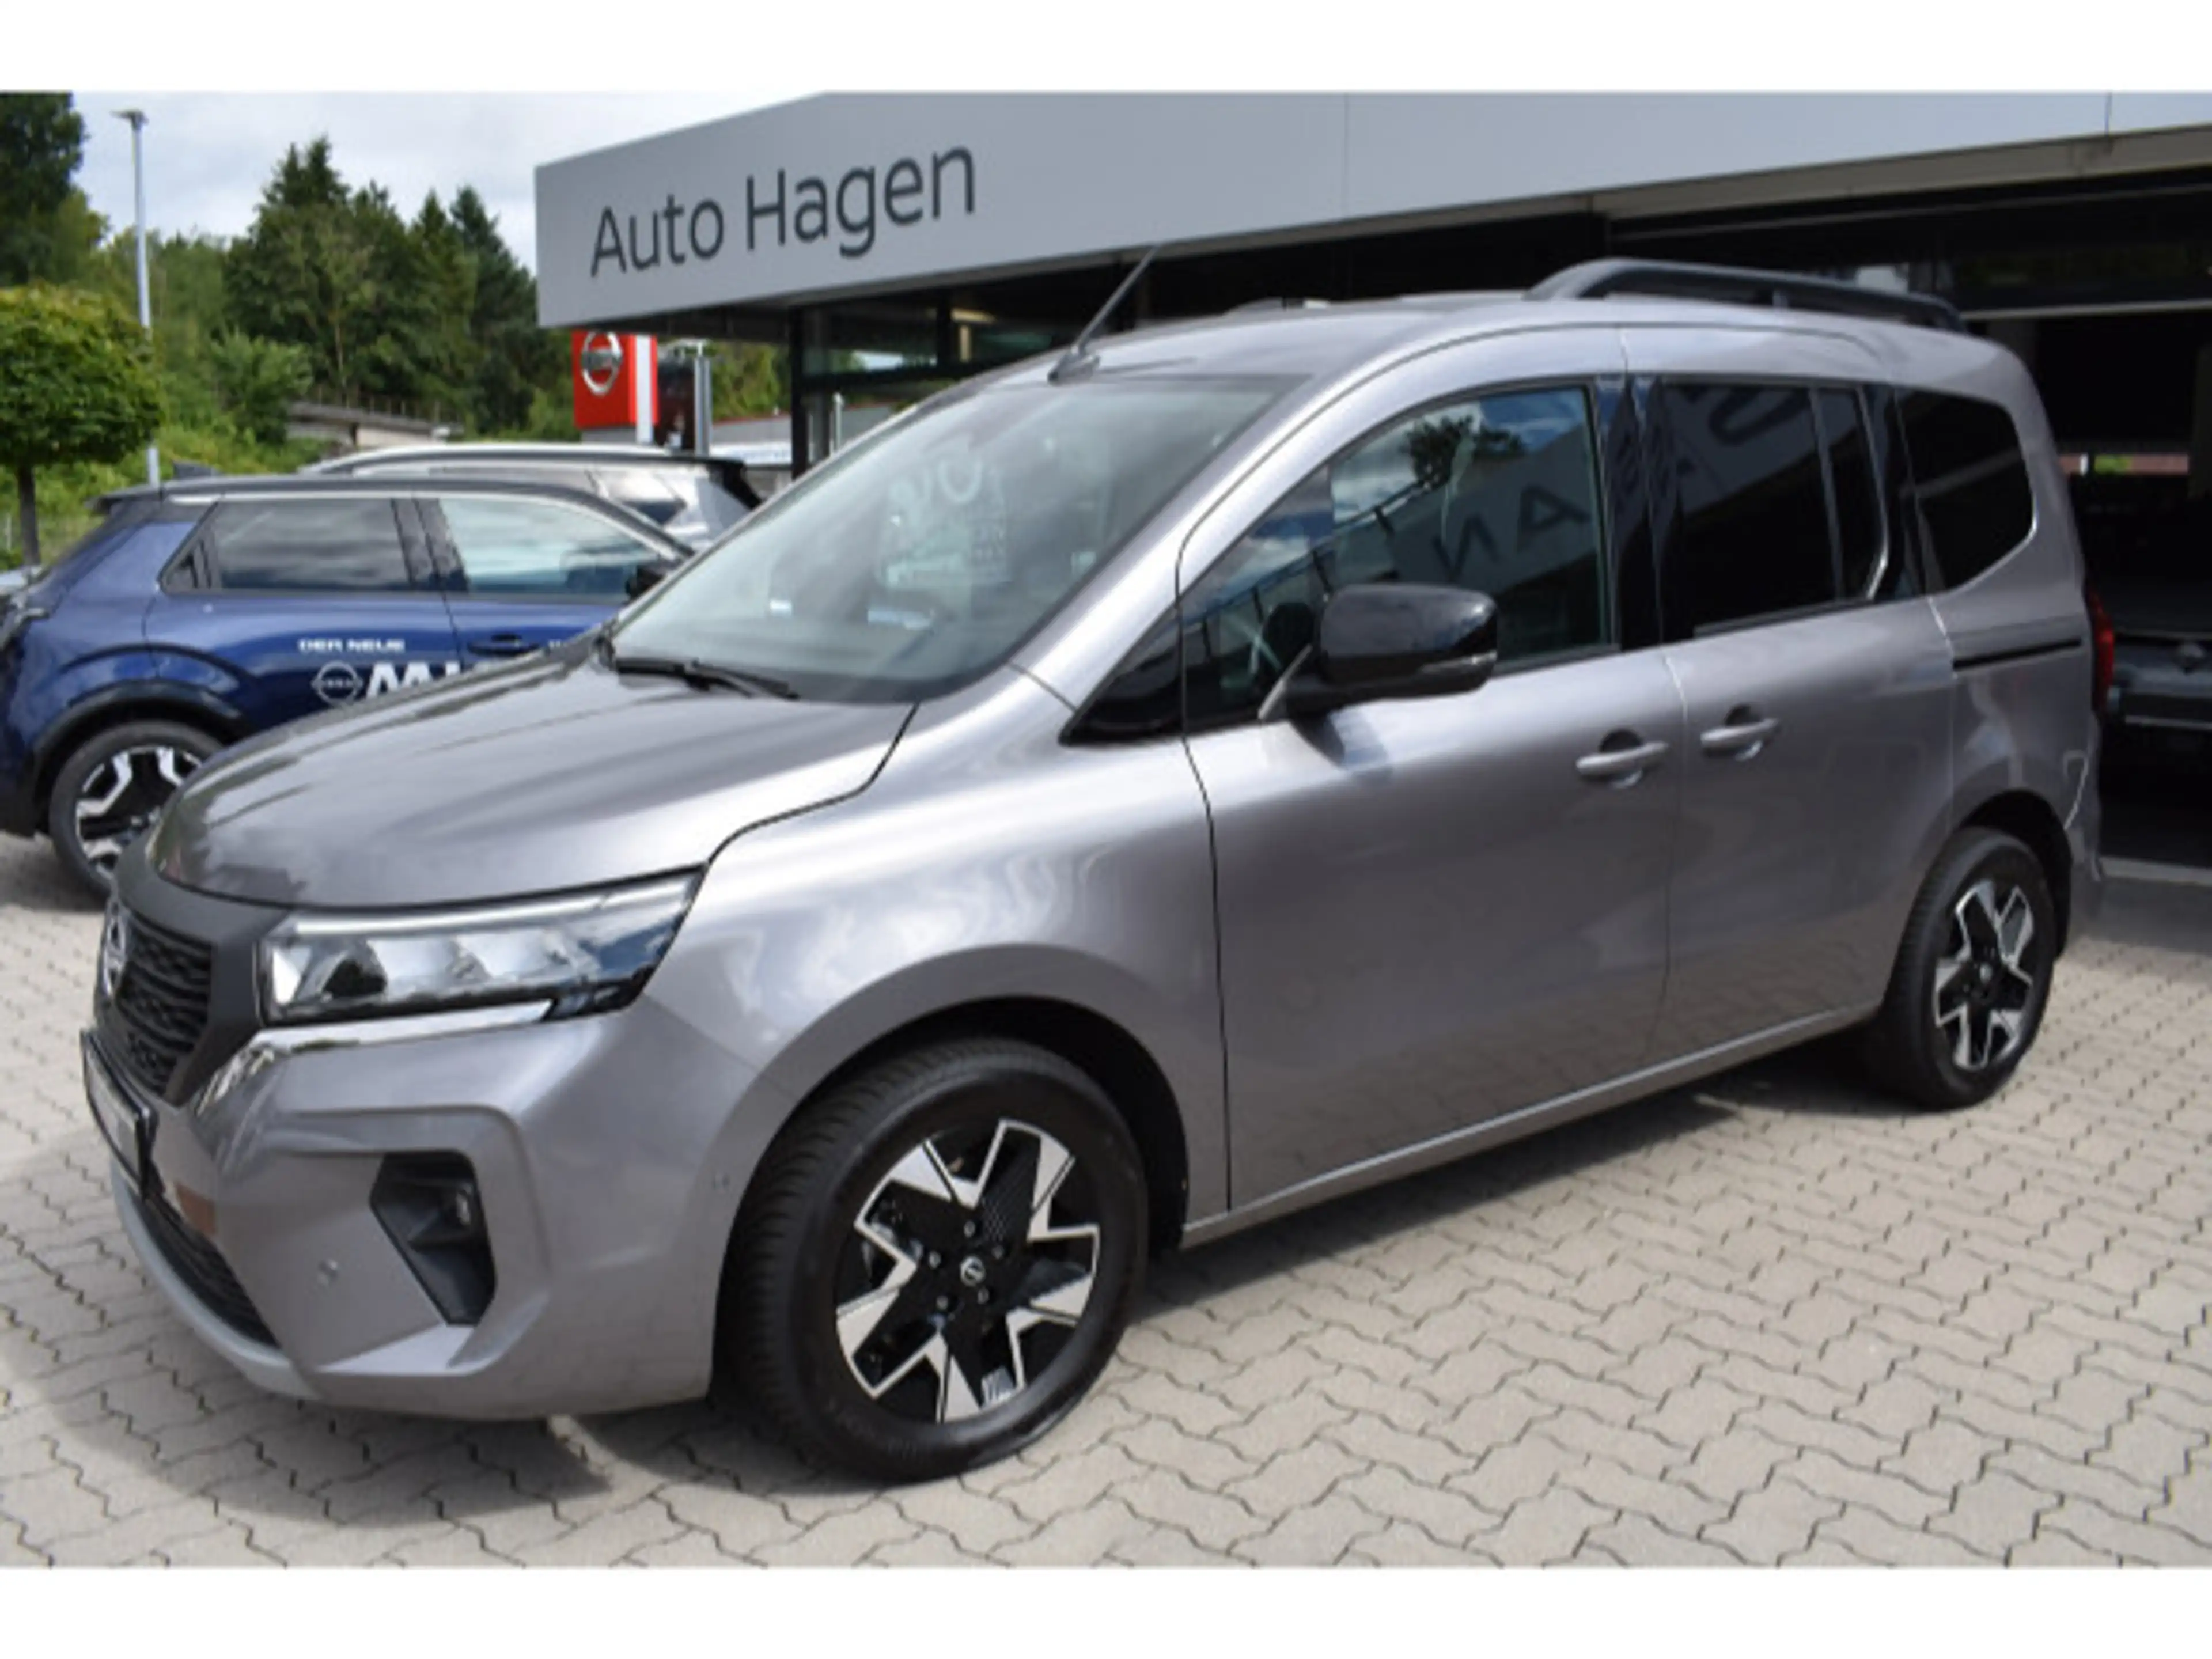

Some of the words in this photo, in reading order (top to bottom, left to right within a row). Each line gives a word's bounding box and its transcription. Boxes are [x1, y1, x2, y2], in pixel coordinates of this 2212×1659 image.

[590, 193, 724, 278] Auto
[746, 146, 975, 257] Hagen
[298, 638, 343, 653] DER
[347, 638, 406, 653] NEUE
